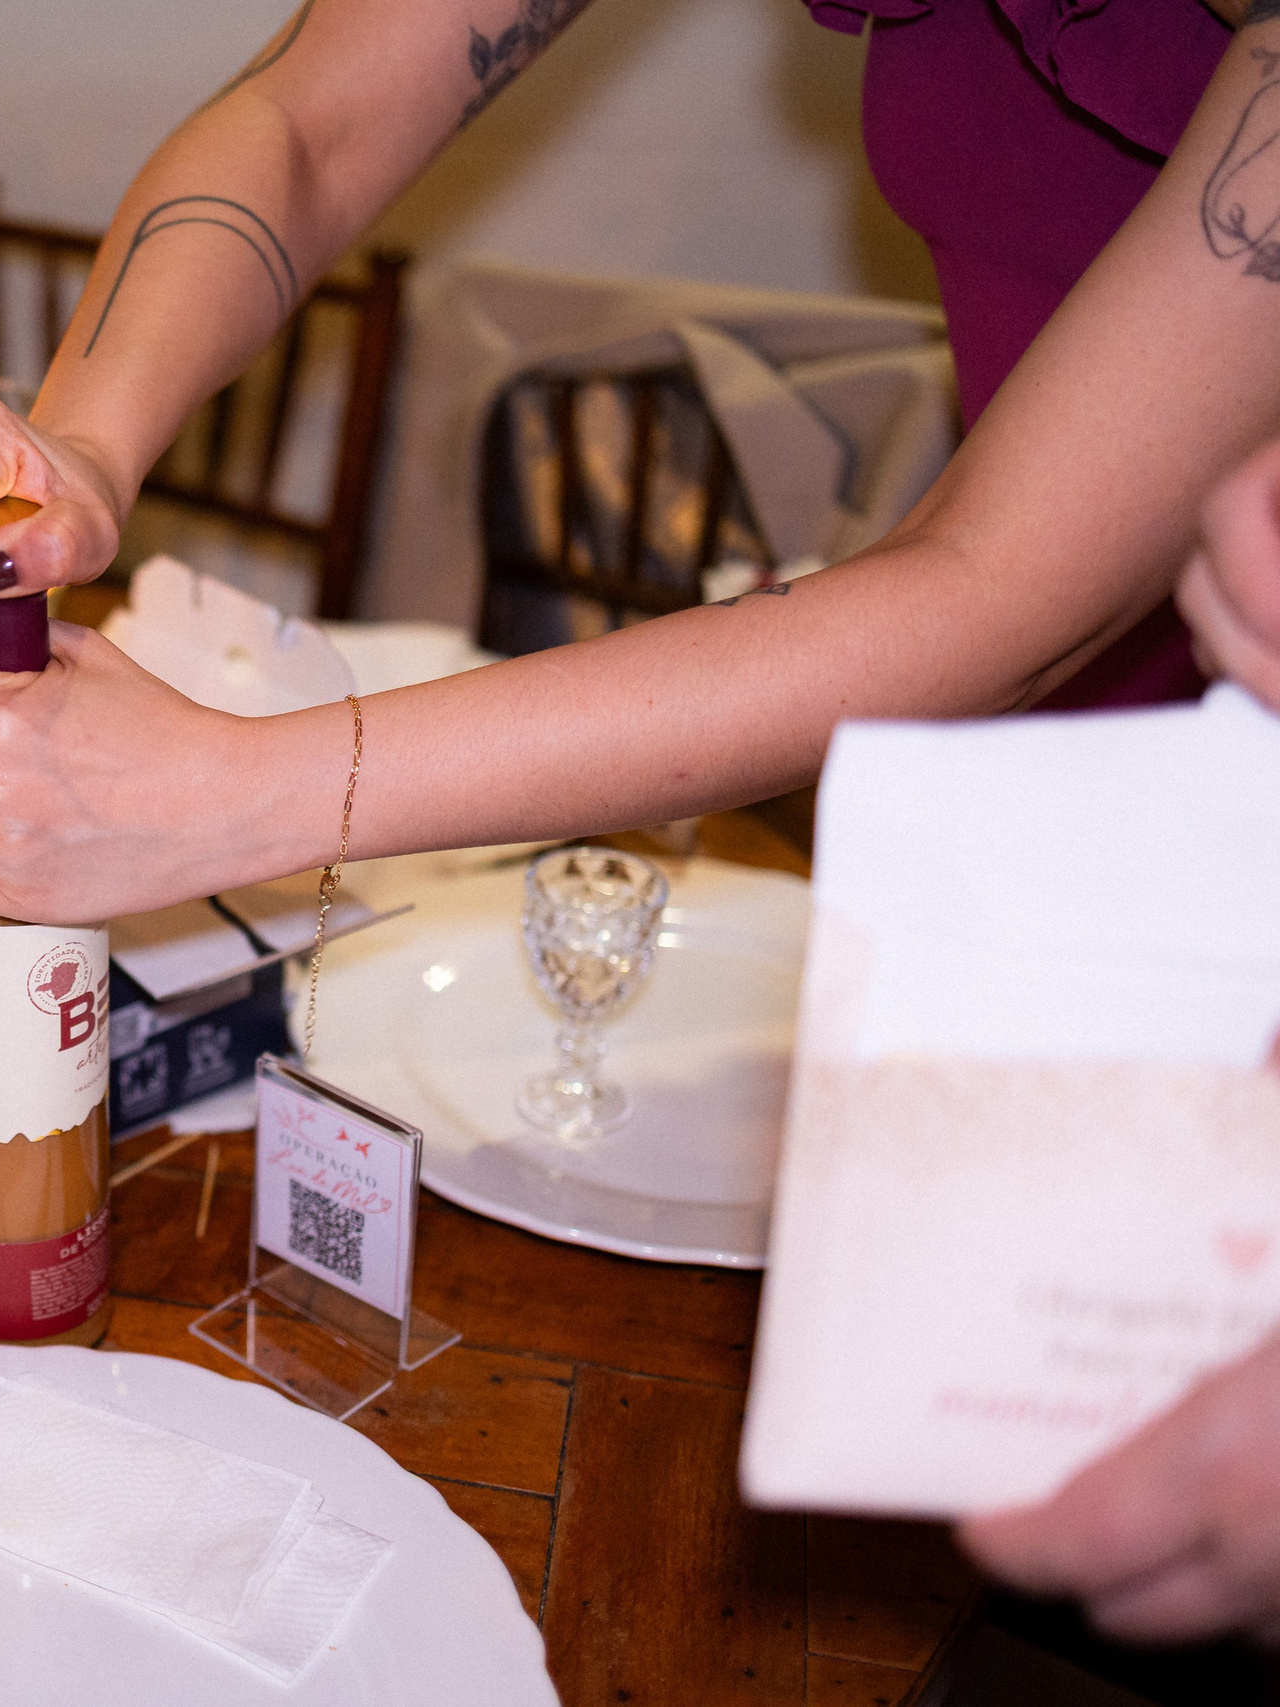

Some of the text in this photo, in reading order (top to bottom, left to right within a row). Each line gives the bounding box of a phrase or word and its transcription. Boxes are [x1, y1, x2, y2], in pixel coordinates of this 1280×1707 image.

[34, 949, 90, 983] IDENTIDADE MINEIRA
[60, 1243, 80, 1259] DE
